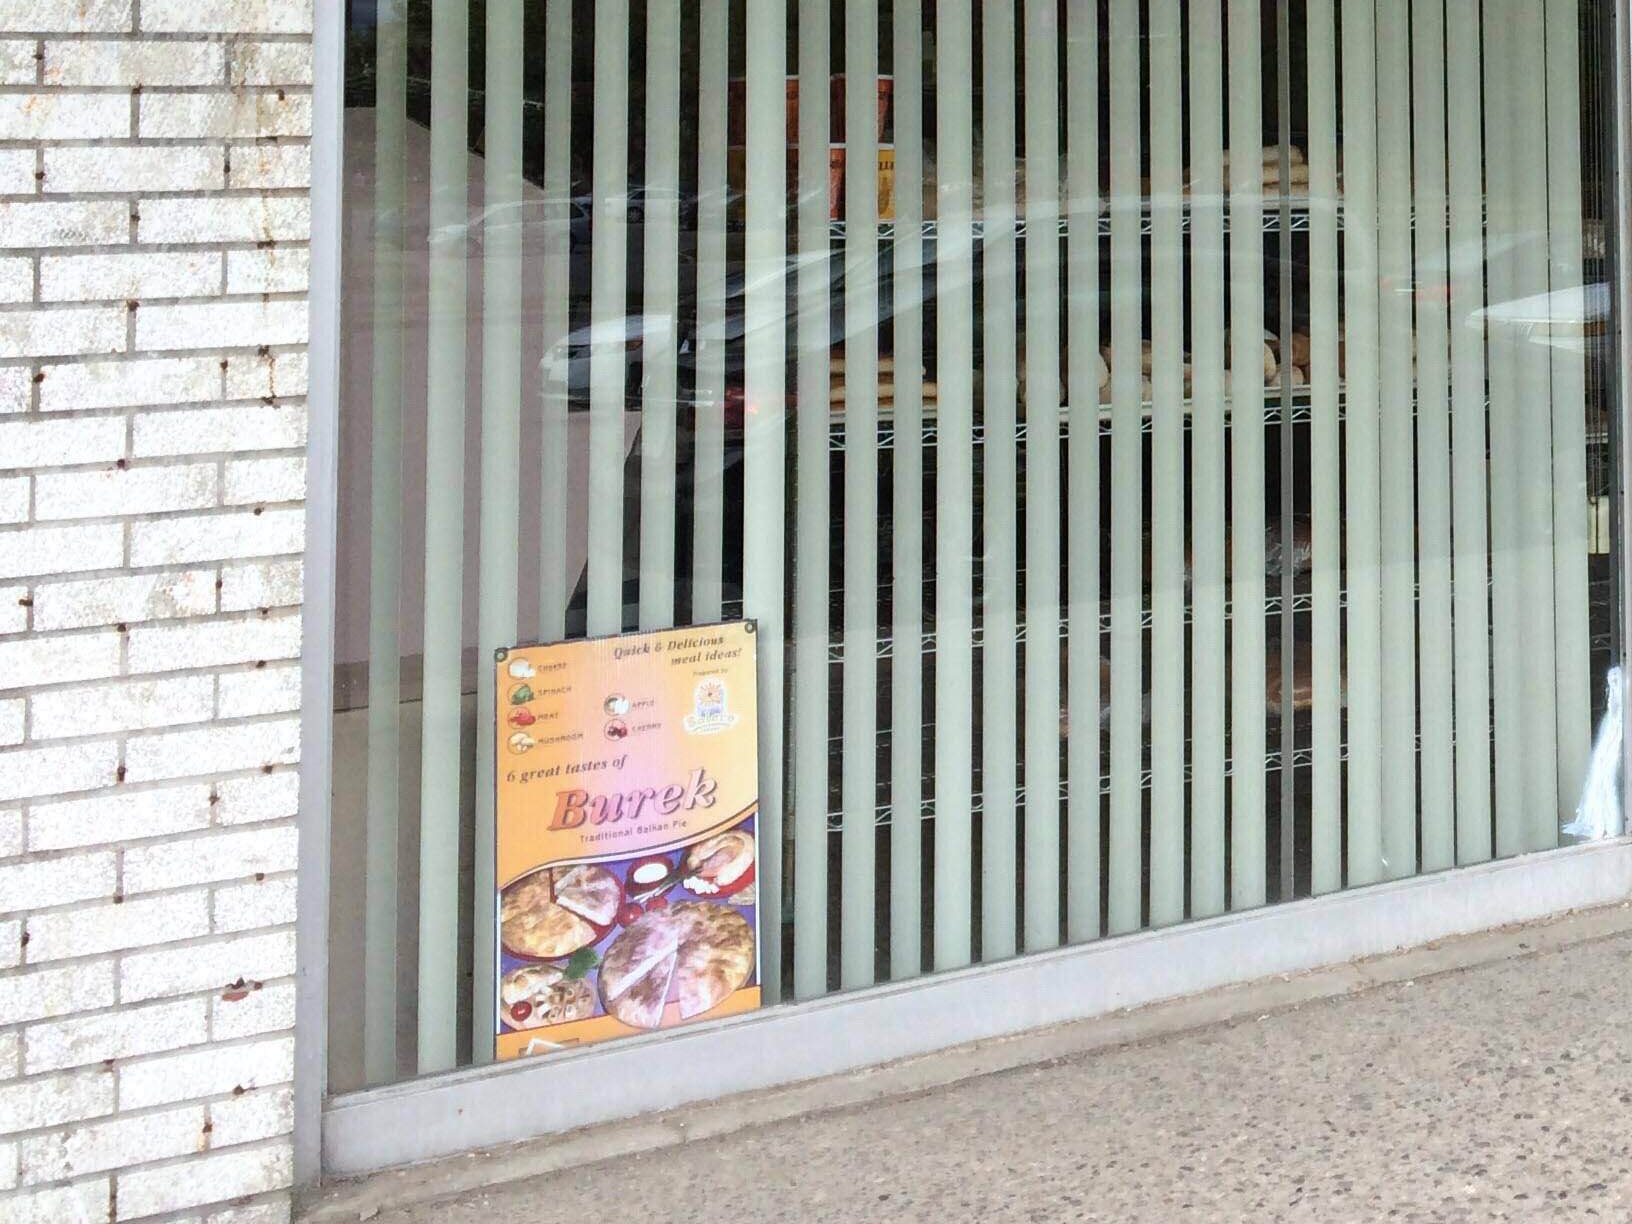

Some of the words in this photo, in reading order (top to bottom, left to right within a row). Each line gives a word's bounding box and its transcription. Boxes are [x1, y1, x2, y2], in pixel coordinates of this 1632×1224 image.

[614, 643, 650, 660] Quick
[667, 636, 724, 651] Delicious
[671, 652, 701, 665] meal
[506, 770, 516, 783] 6
[520, 764, 560, 784] great
[565, 759, 608, 775] tastes
[612, 754, 628, 770] of
[547, 766, 718, 832] Burek
[581, 827, 633, 844] Traditional
